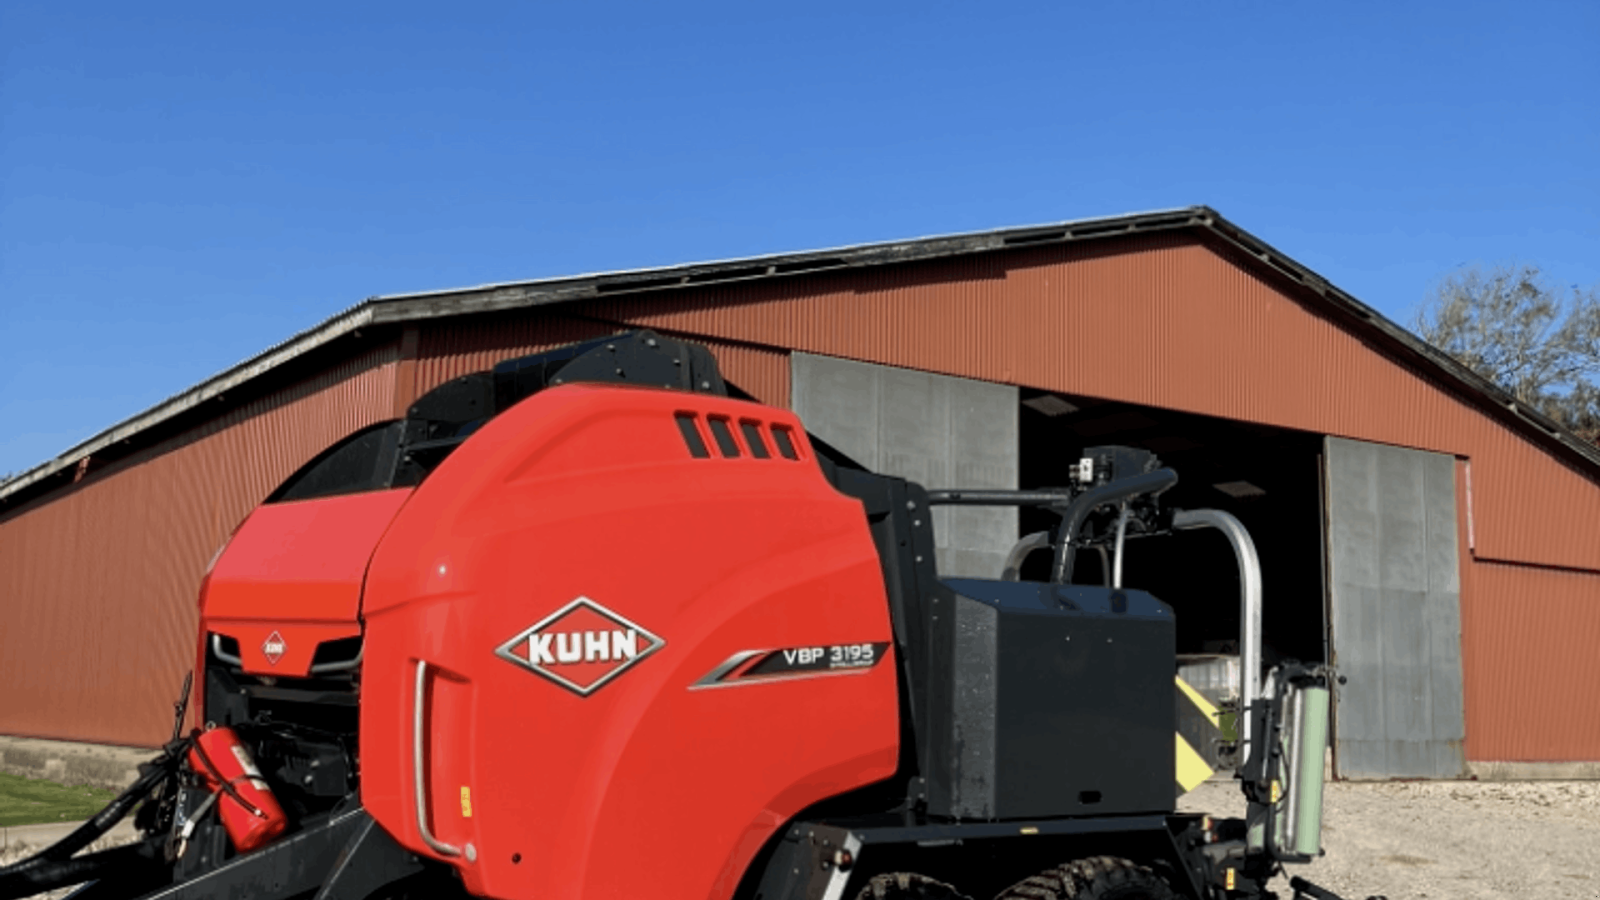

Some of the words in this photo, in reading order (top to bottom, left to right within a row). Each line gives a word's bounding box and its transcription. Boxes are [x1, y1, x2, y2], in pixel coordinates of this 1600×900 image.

[528, 629, 637, 664] KUHN
[783, 647, 825, 665] VBP
[830, 644, 874, 662] 3195
